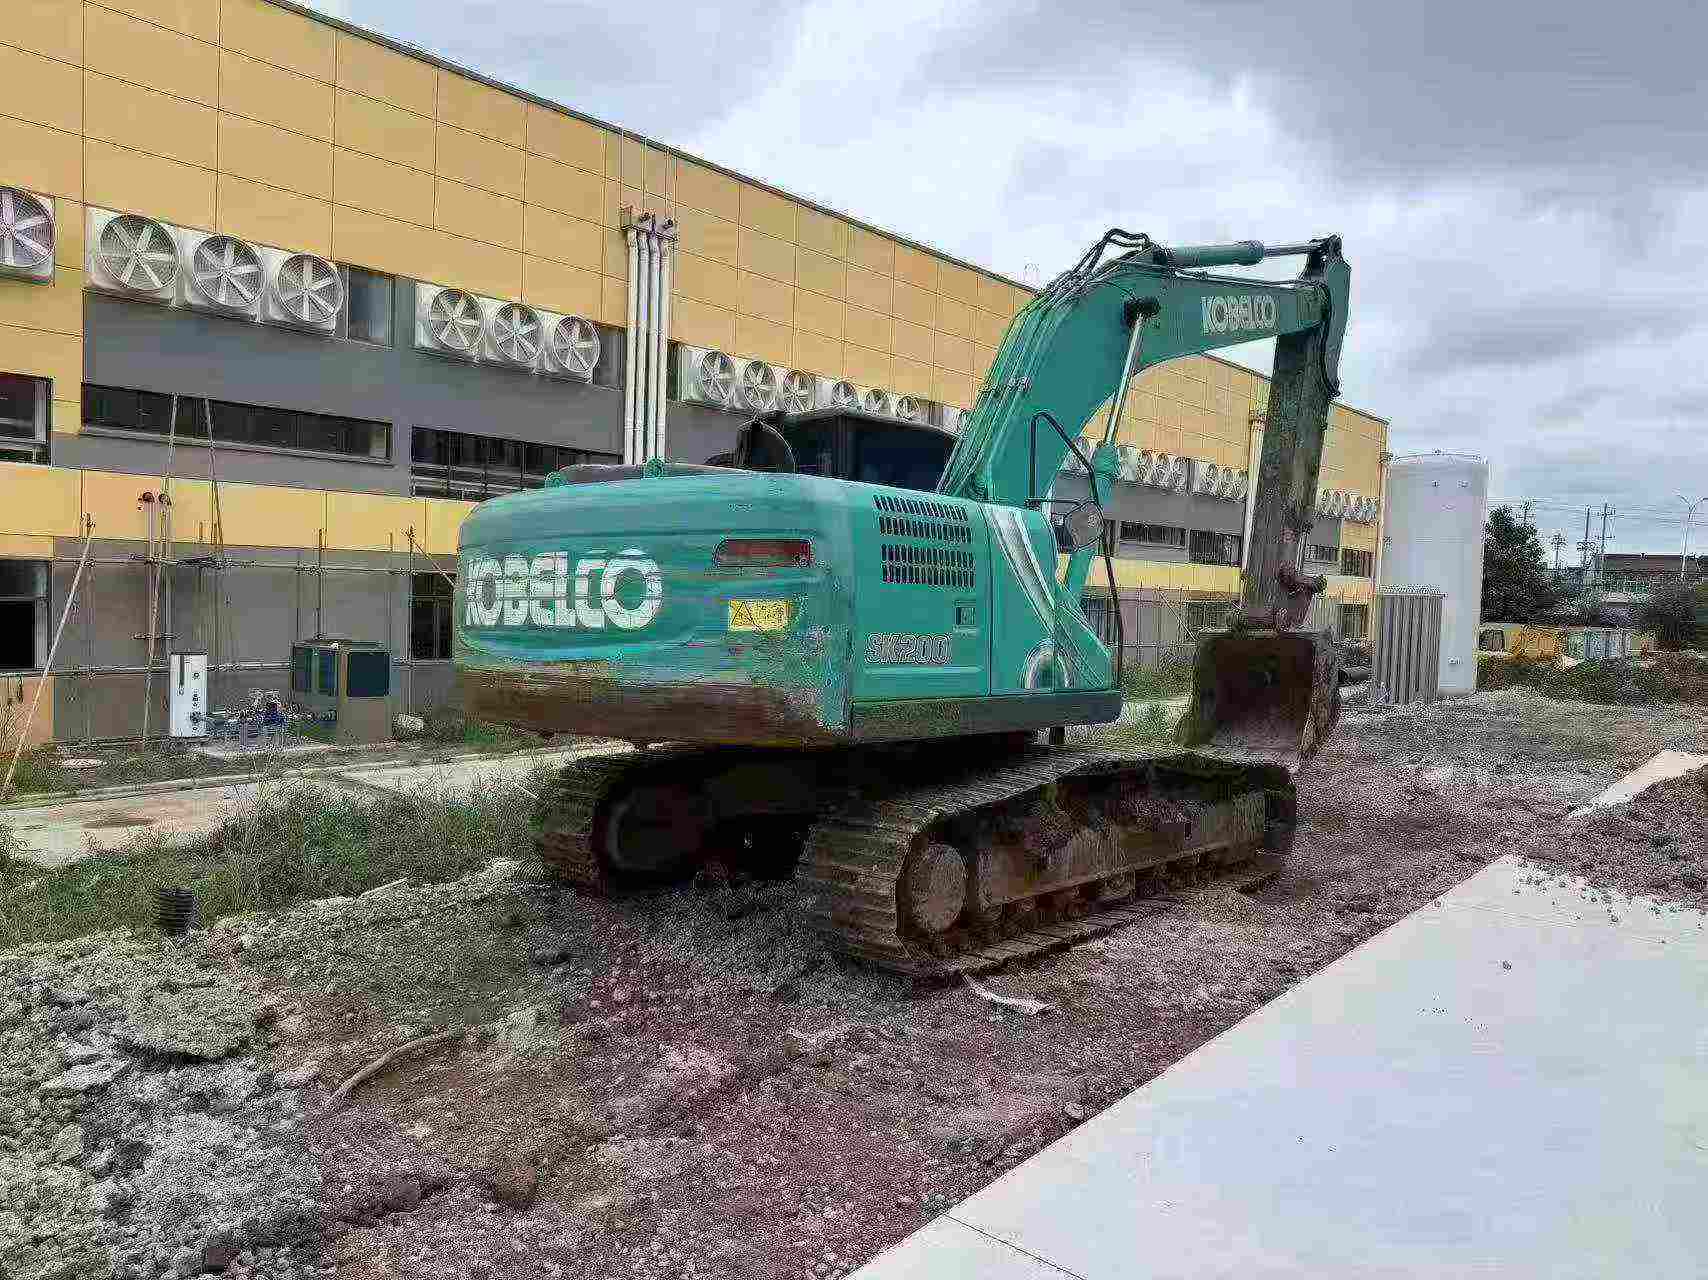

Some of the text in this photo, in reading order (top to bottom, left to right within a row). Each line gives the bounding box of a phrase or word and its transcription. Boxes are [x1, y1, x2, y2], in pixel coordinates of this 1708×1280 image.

[1201, 295, 1275, 333] KOBELCO
[465, 549, 662, 630] KOBELCO
[866, 634, 950, 664] SK200
